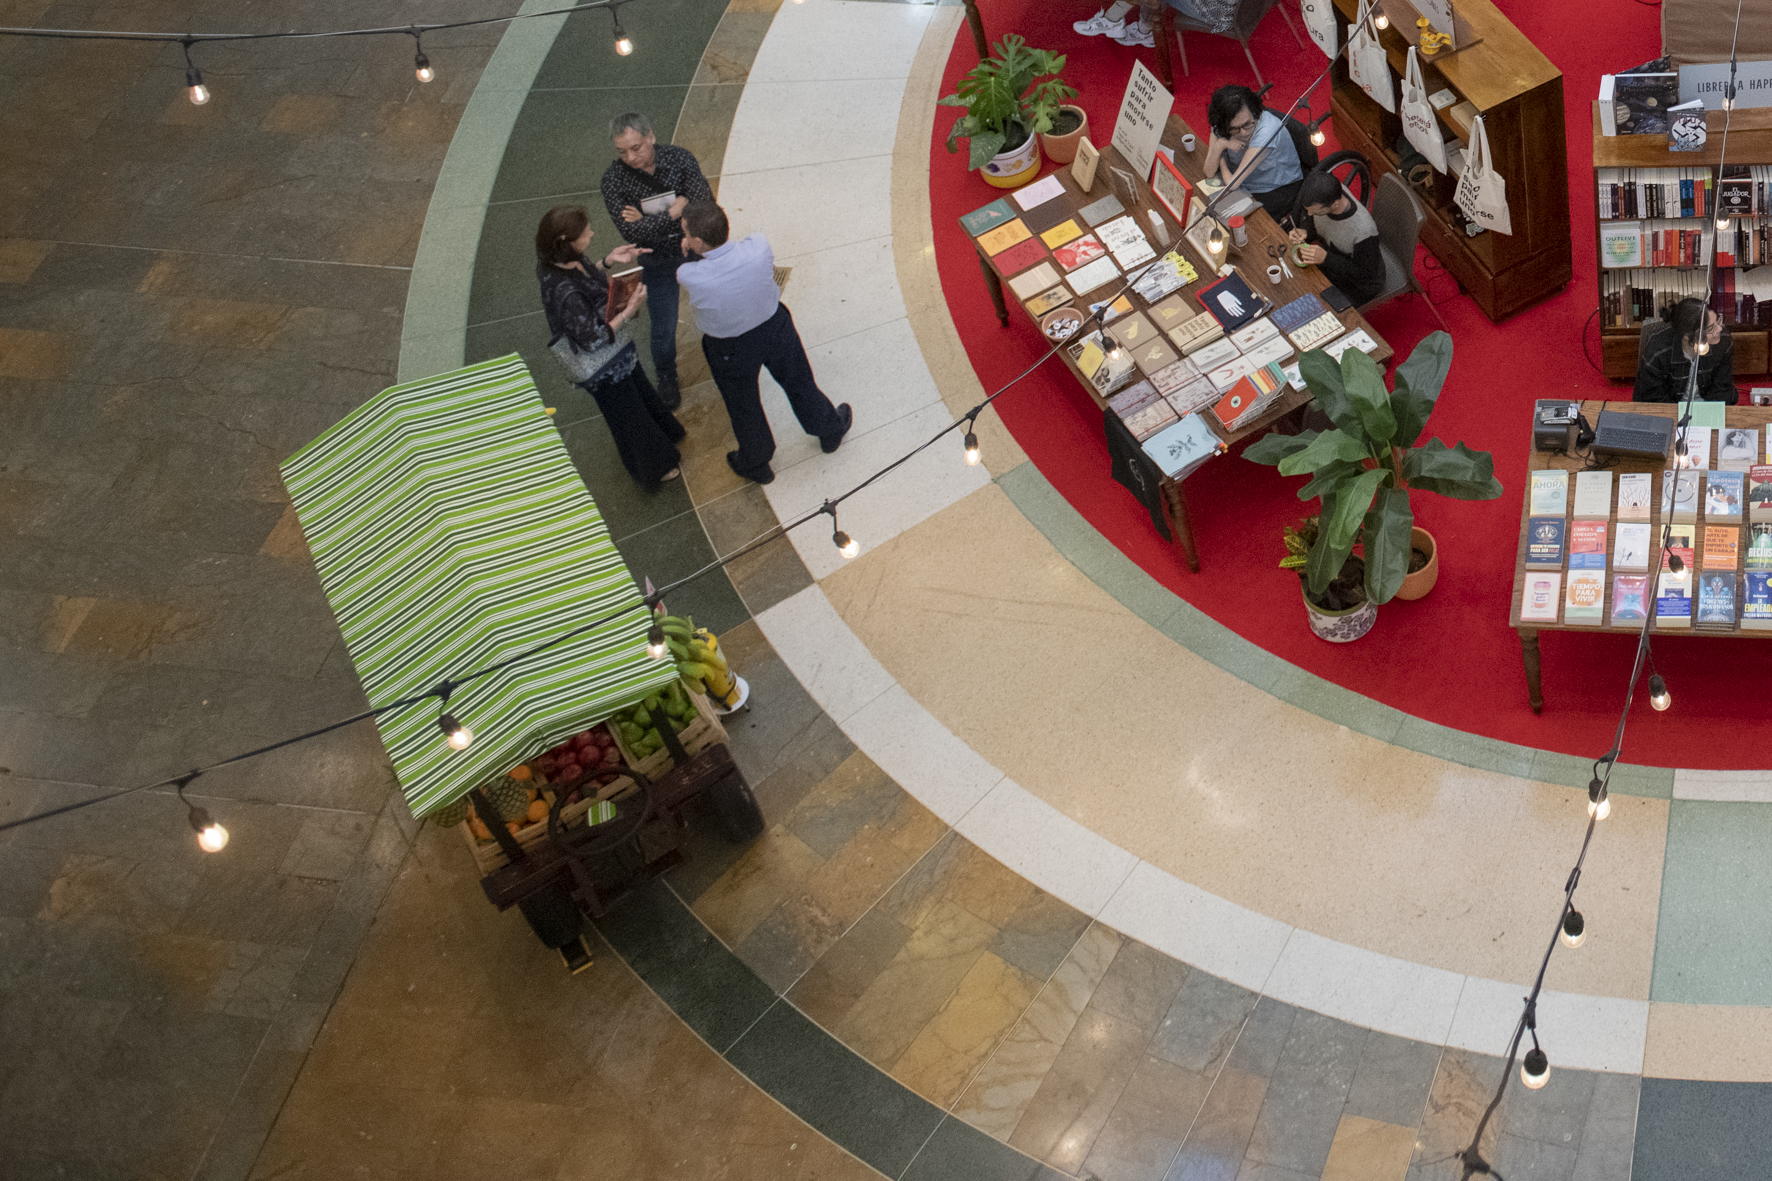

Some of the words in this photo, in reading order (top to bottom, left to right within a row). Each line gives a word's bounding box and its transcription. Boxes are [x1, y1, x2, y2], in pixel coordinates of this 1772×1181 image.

[1138, 67, 1157, 93] Tanto
[1697, 80, 1744, 93] LIBRERA
[1130, 90, 1147, 110] para
[1134, 80, 1154, 103] sufrir
[1124, 110, 1137, 126] uno
[1127, 100, 1154, 131] morirse
[1532, 481, 1566, 490] AHORA
